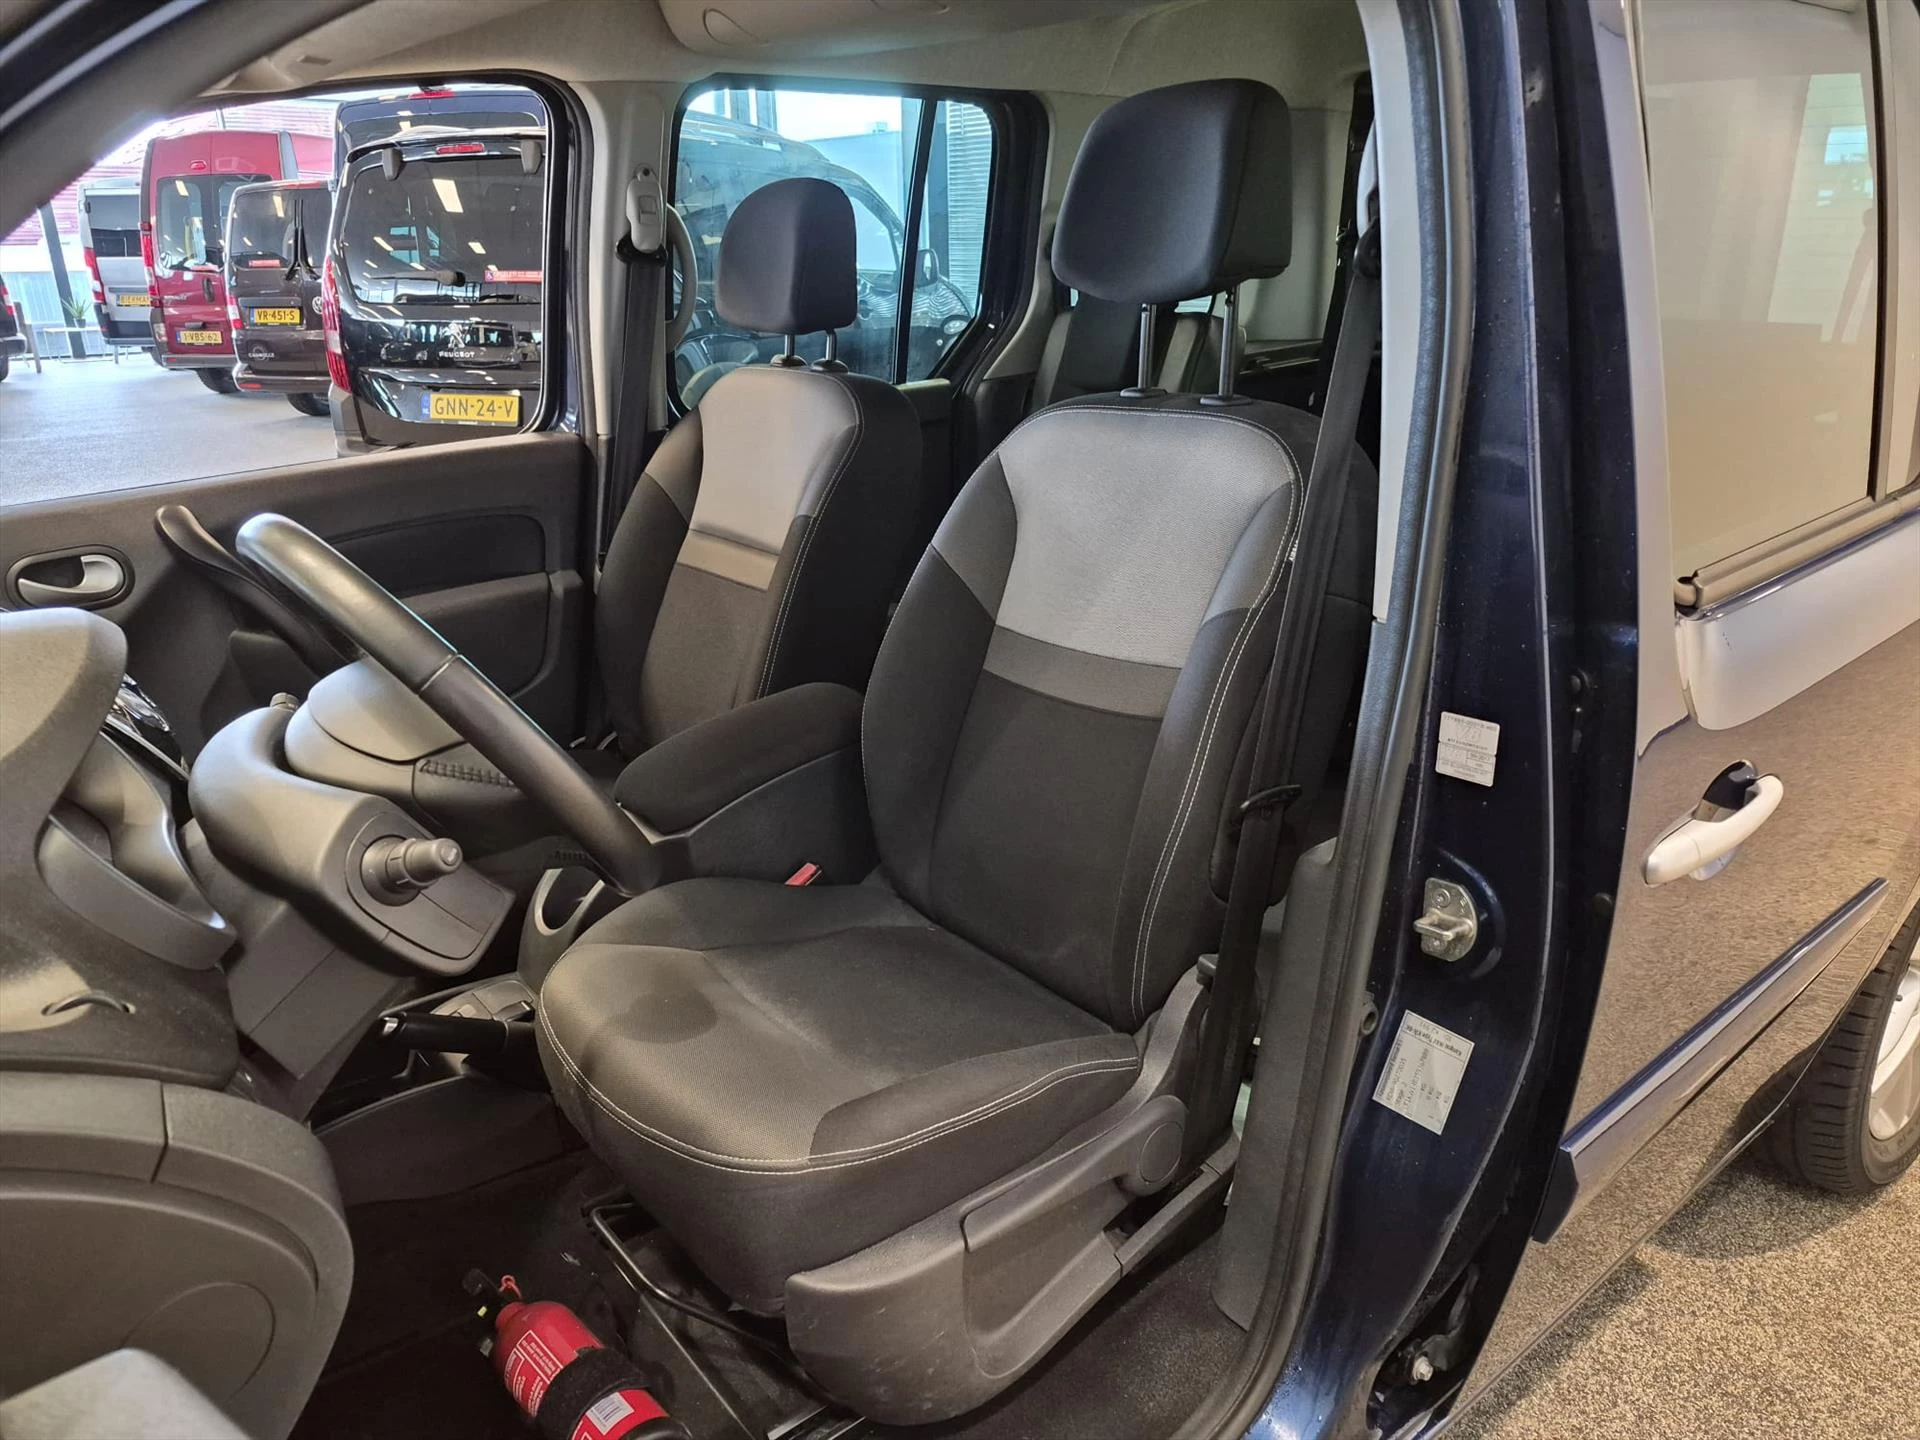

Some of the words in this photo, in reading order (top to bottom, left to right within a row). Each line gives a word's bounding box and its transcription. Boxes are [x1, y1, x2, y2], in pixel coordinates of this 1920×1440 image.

[256, 311, 296, 321] VR-451-S
[183, 332, 218, 342] 1-VBS-62
[433, 397, 515, 418] GNN-24-V
